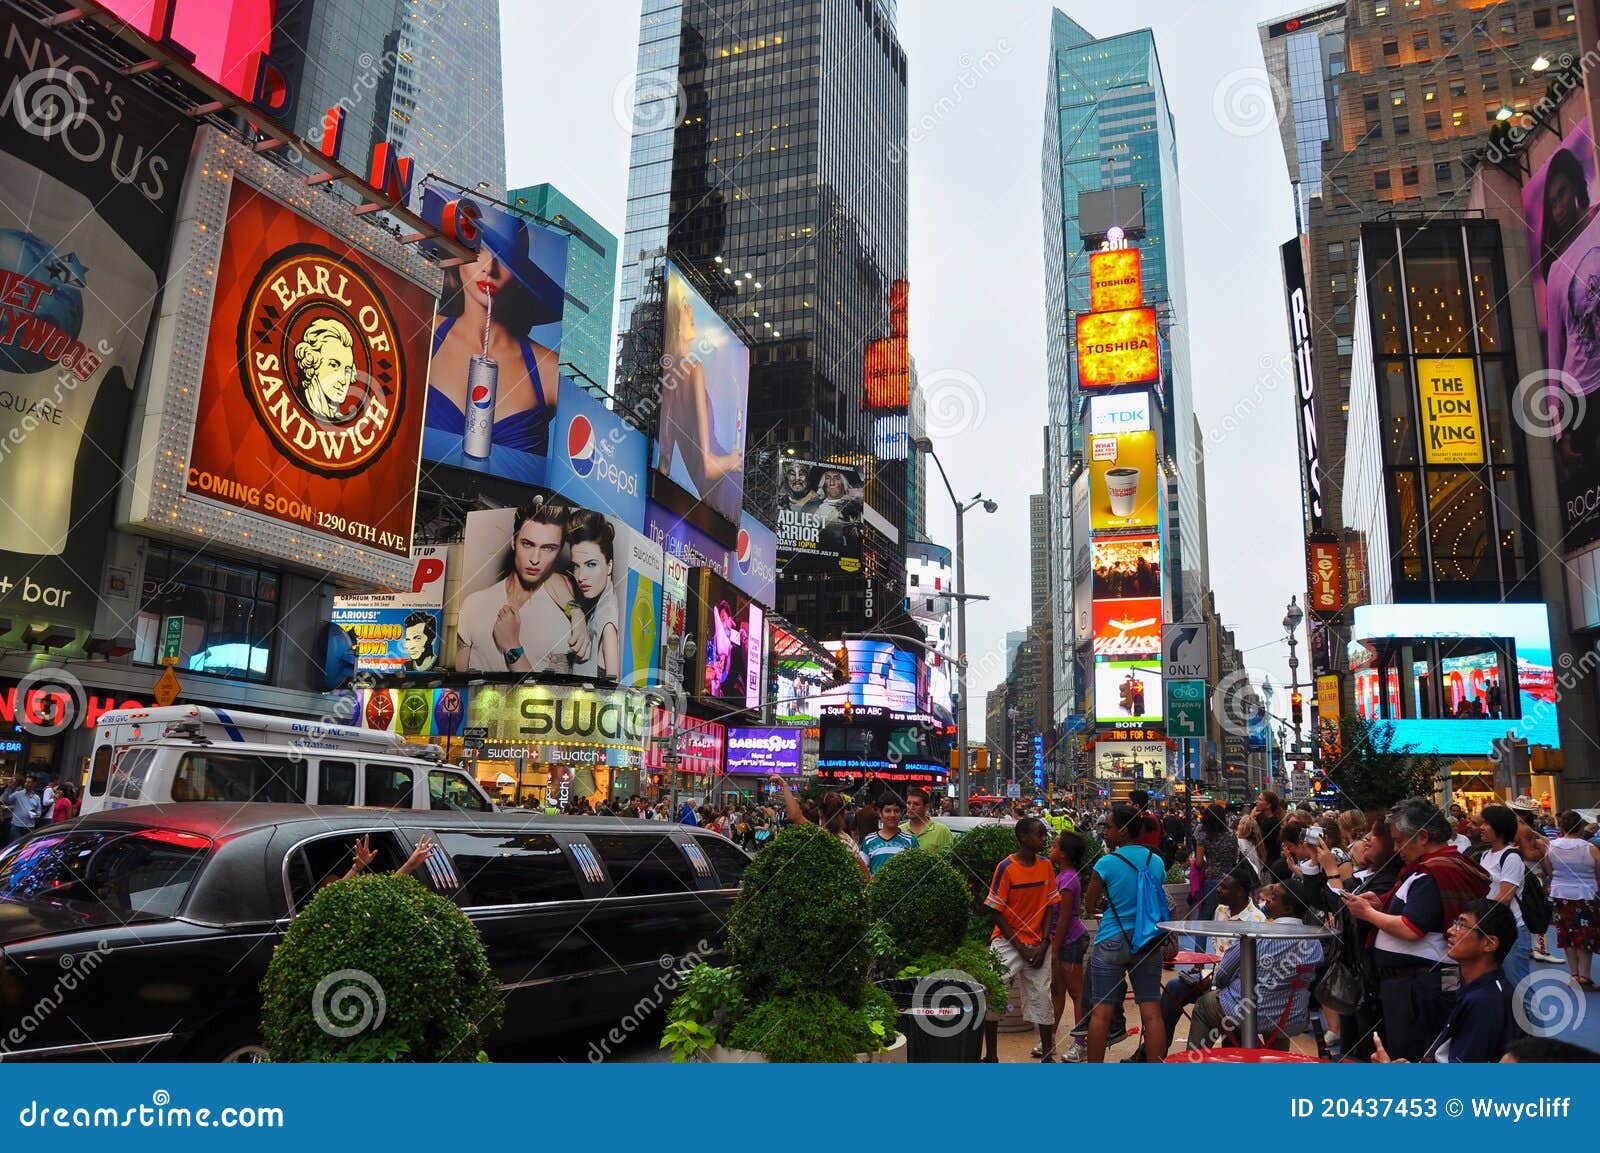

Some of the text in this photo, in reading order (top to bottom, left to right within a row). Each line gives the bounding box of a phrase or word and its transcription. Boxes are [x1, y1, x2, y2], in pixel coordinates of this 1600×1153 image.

[1101, 239, 1128, 252] 2011
[1096, 277, 1136, 288] TOSHIBA
[271, 266, 391, 352] EARL OF
[1087, 339, 1149, 354] TOSHIBA
[1431, 378, 1463, 392] THE
[255, 351, 389, 459] SANDWICH
[1427, 397, 1471, 421] LION
[1108, 410, 1143, 422] TDK
[1429, 424, 1476, 449] KING
[597, 456, 638, 497] pepsi
[187, 467, 408, 552] COMING SOON 1290 6TH AVE.
[414, 548, 436, 556] IT UP
[668, 559, 687, 586] HOT
[22, 576, 71, 609] bar
[864, 580, 873, 618] 1500
[1169, 665, 1201, 675] ONLY
[1171, 701, 1201, 709] Broadway
[867, 708, 883, 716] ABC
[6, 743, 21, 751] BAR
[487, 747, 530, 759] swatch
[1131, 745, 1163, 753] 40 MPG
[552, 750, 600, 762] swatch
[751, 752, 765, 760] Now
